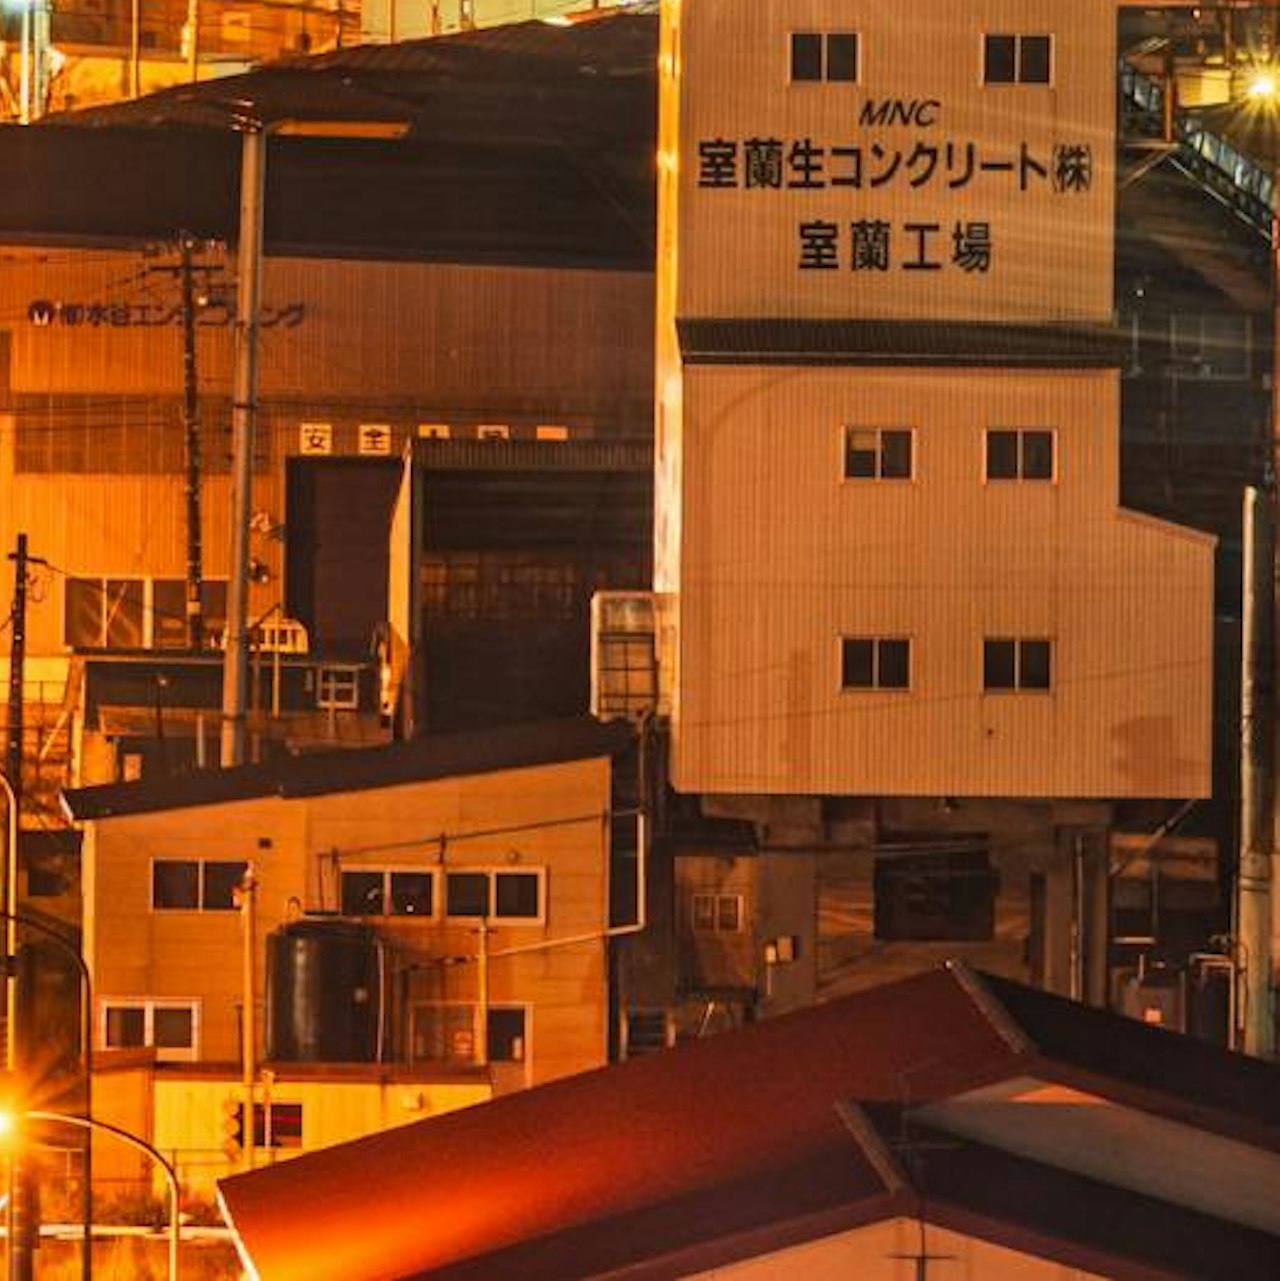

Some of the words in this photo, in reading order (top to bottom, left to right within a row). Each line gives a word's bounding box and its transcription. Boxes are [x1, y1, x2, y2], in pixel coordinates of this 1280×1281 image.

[858, 99, 941, 127] MNC
[798, 220, 993, 273] 室蘭工場
